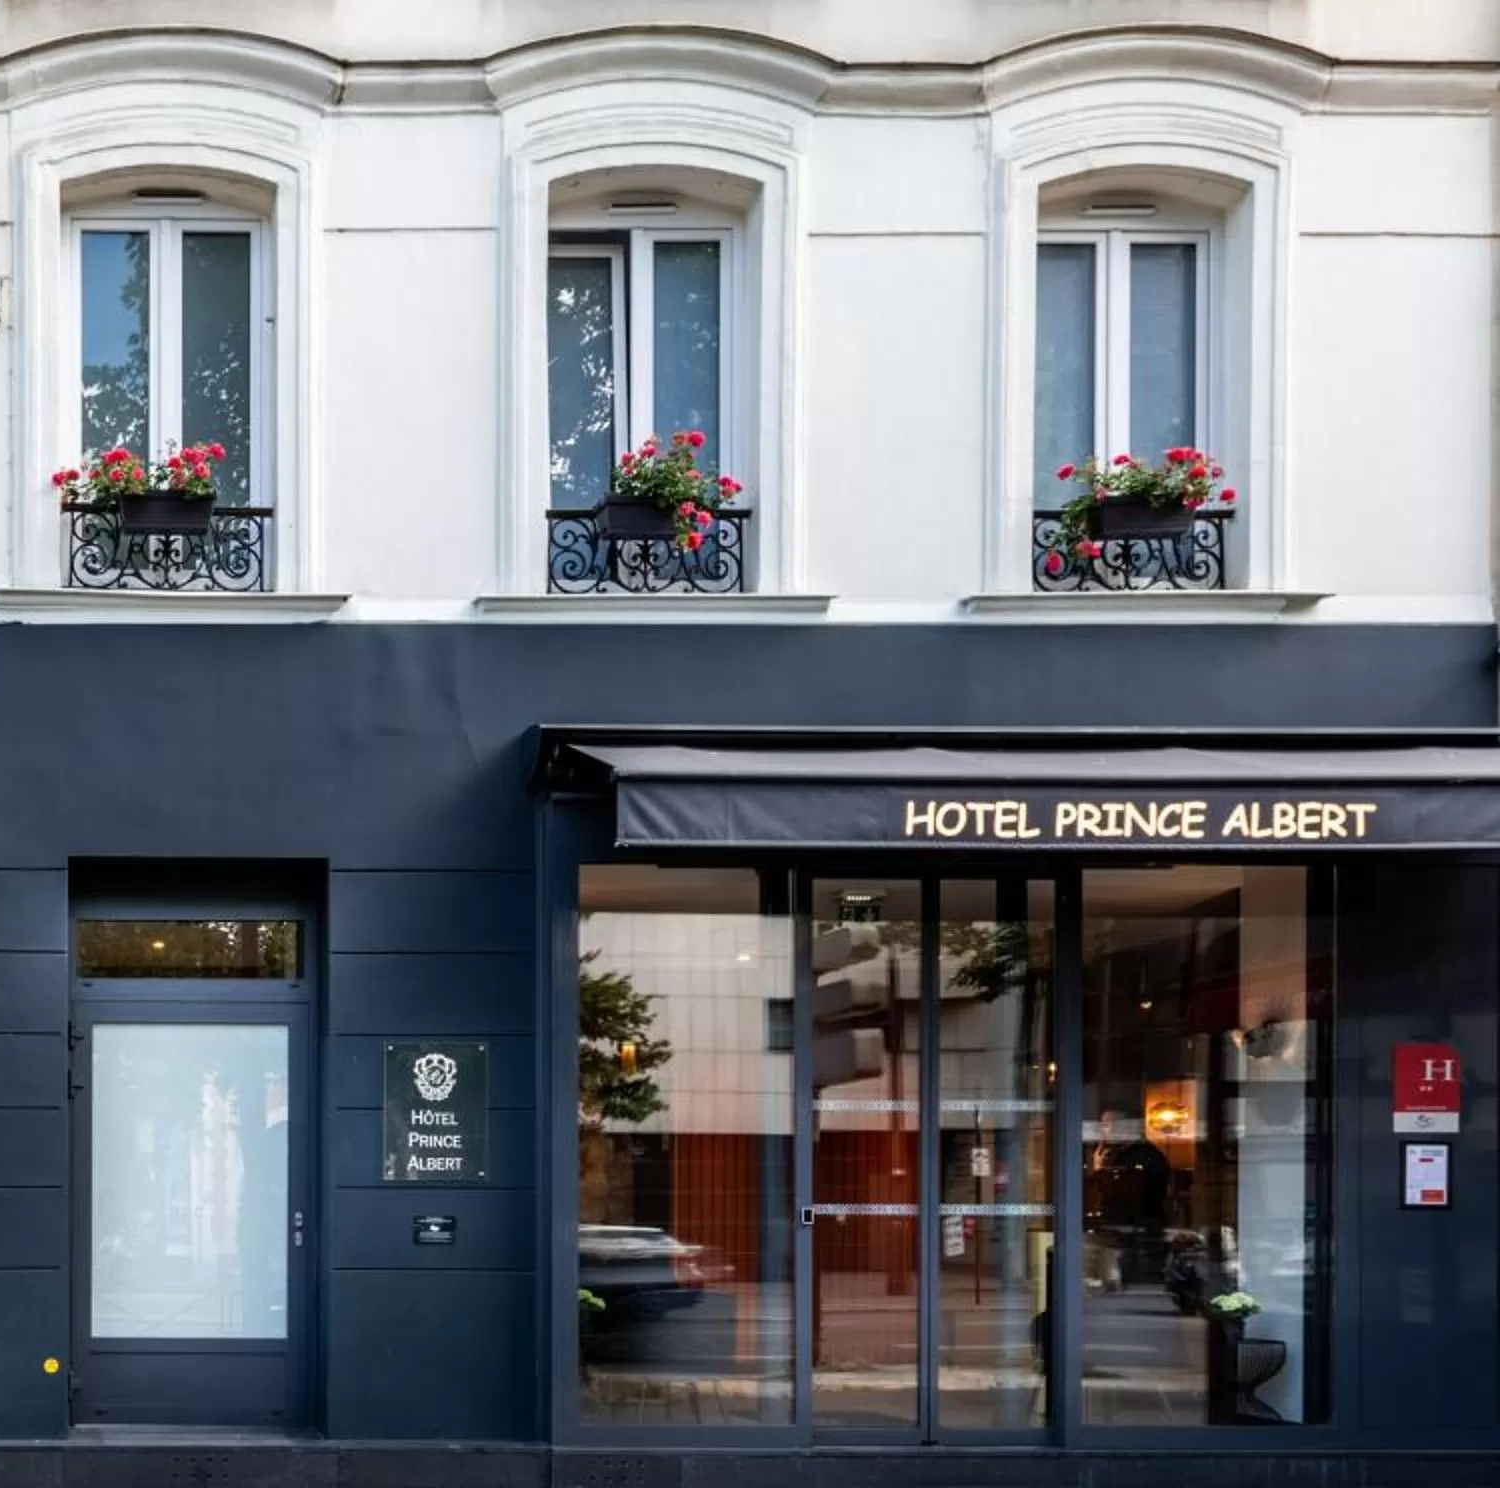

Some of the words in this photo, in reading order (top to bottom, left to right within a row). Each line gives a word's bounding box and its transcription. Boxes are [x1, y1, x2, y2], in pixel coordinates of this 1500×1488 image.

[905, 800, 1040, 838] HOTEL
[1054, 800, 1207, 839] PRINCE
[1221, 801, 1377, 839] ALBERT
[1422, 1059, 1456, 1081] H
[411, 1108, 459, 1126] HÔTEL
[408, 1131, 463, 1149] PRINCE
[407, 1155, 463, 1171] ALBERT
